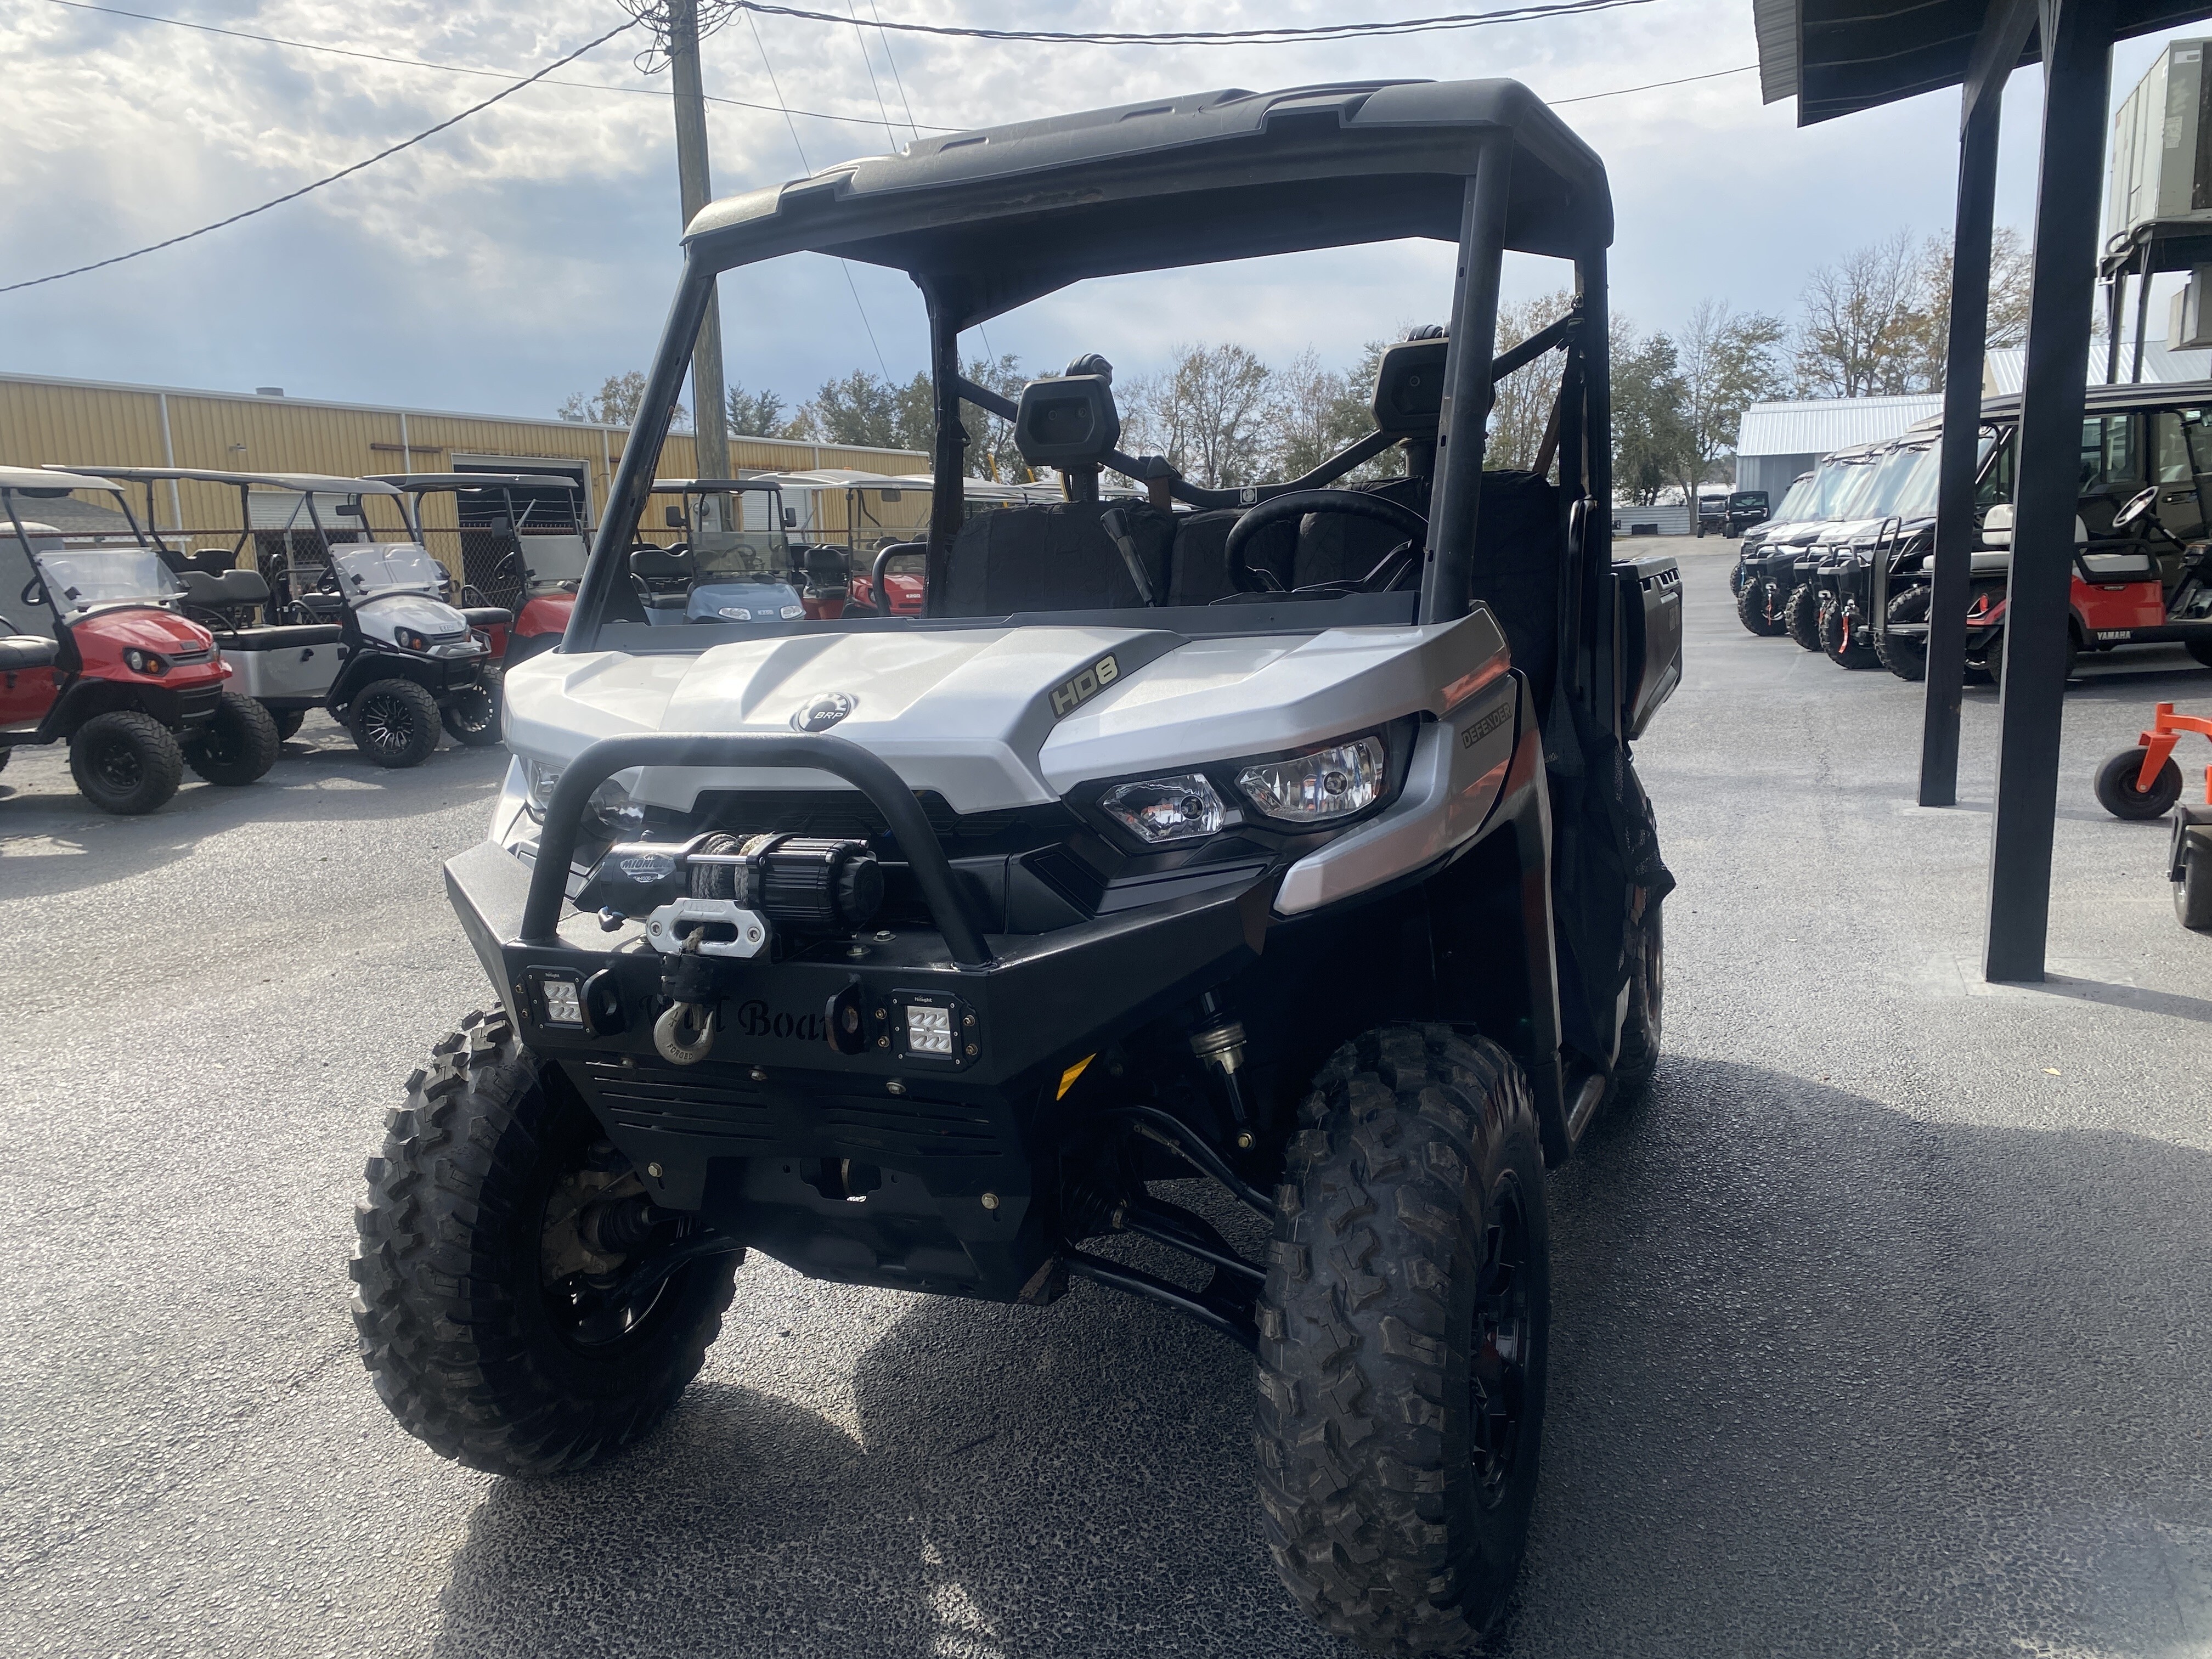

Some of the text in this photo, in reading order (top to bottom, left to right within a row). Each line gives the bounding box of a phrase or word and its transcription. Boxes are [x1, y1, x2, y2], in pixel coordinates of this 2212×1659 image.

[2097, 631, 2131, 640] YAMAHA
[1052, 656, 1118, 715] HD8
[1463, 704, 1512, 747] DEFENDER
[666, 1043, 693, 1060] FORGED
